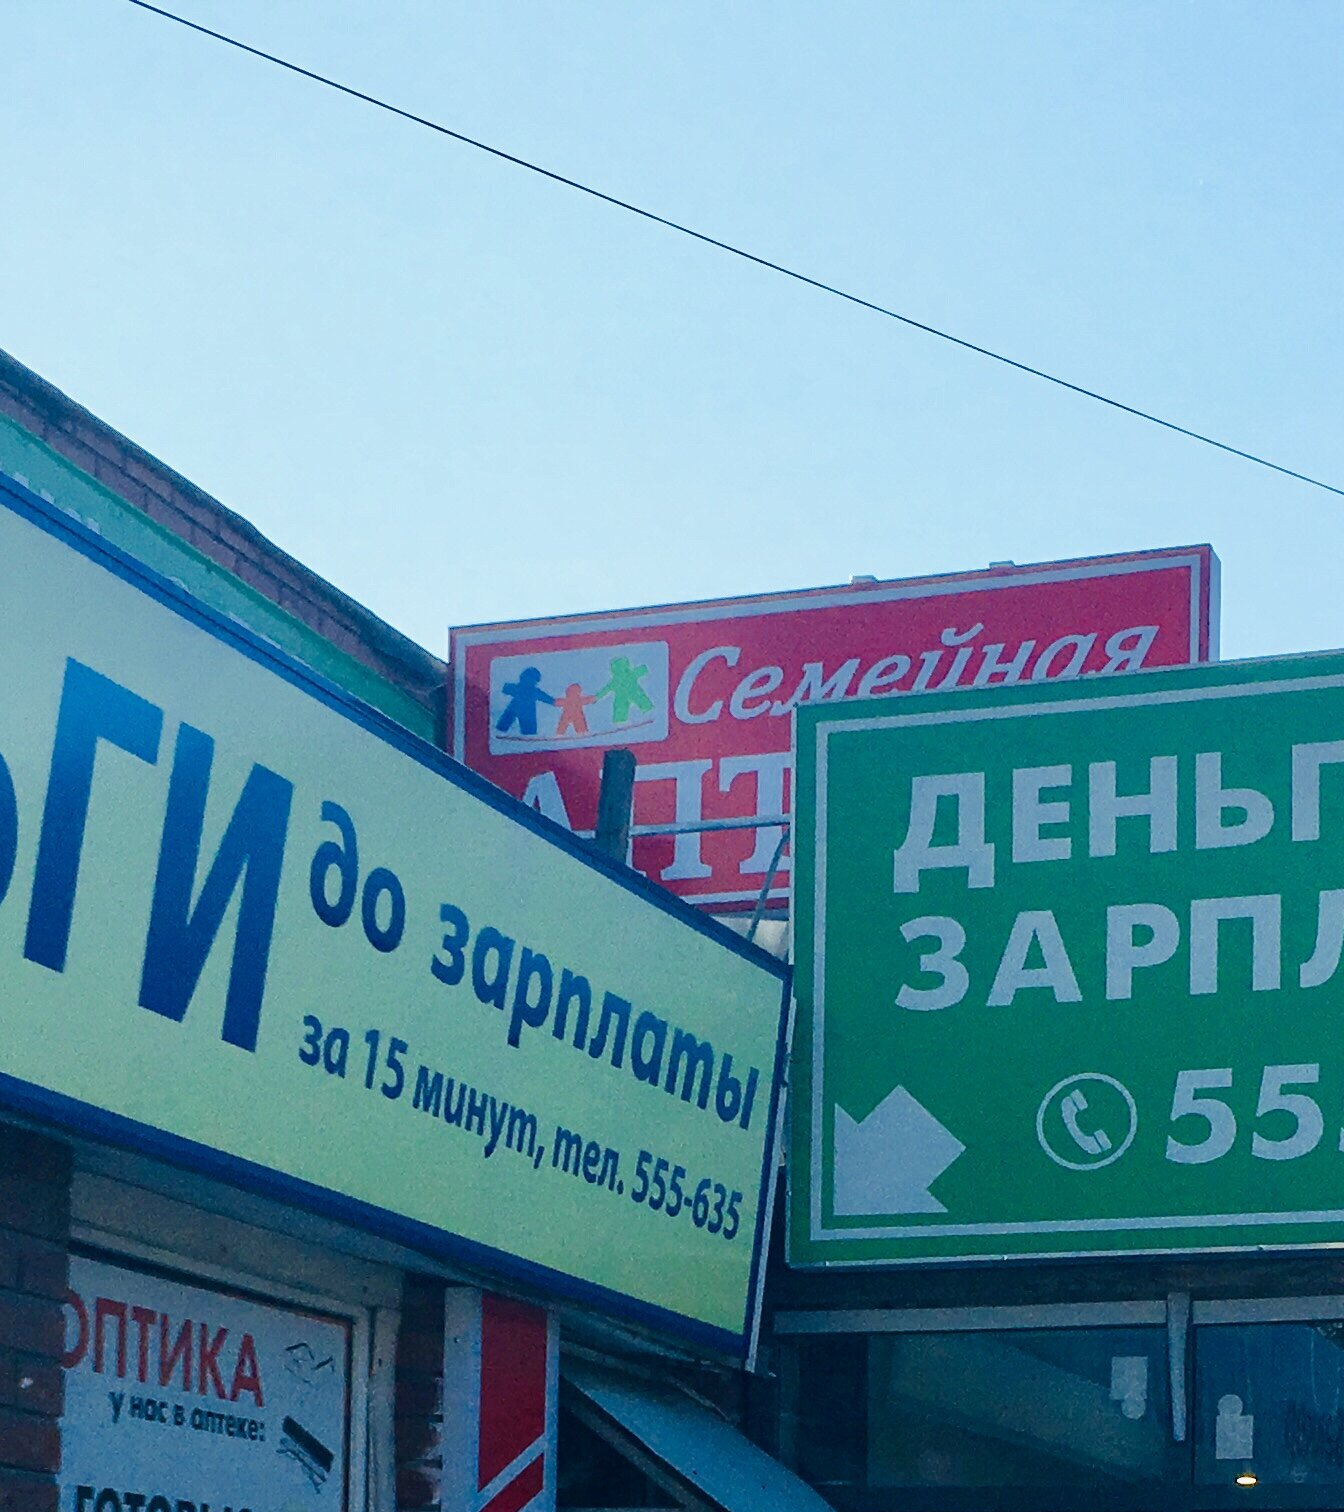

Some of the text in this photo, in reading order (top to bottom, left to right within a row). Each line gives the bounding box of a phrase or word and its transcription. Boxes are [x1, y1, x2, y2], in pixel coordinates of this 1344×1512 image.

[674, 623, 1160, 726] Семейная
[309, 800, 760, 1131] до зарплаты
[298, 1013, 744, 1241] за 15 минут, тел. 555-635
[108, 1391, 121, 1424] у
